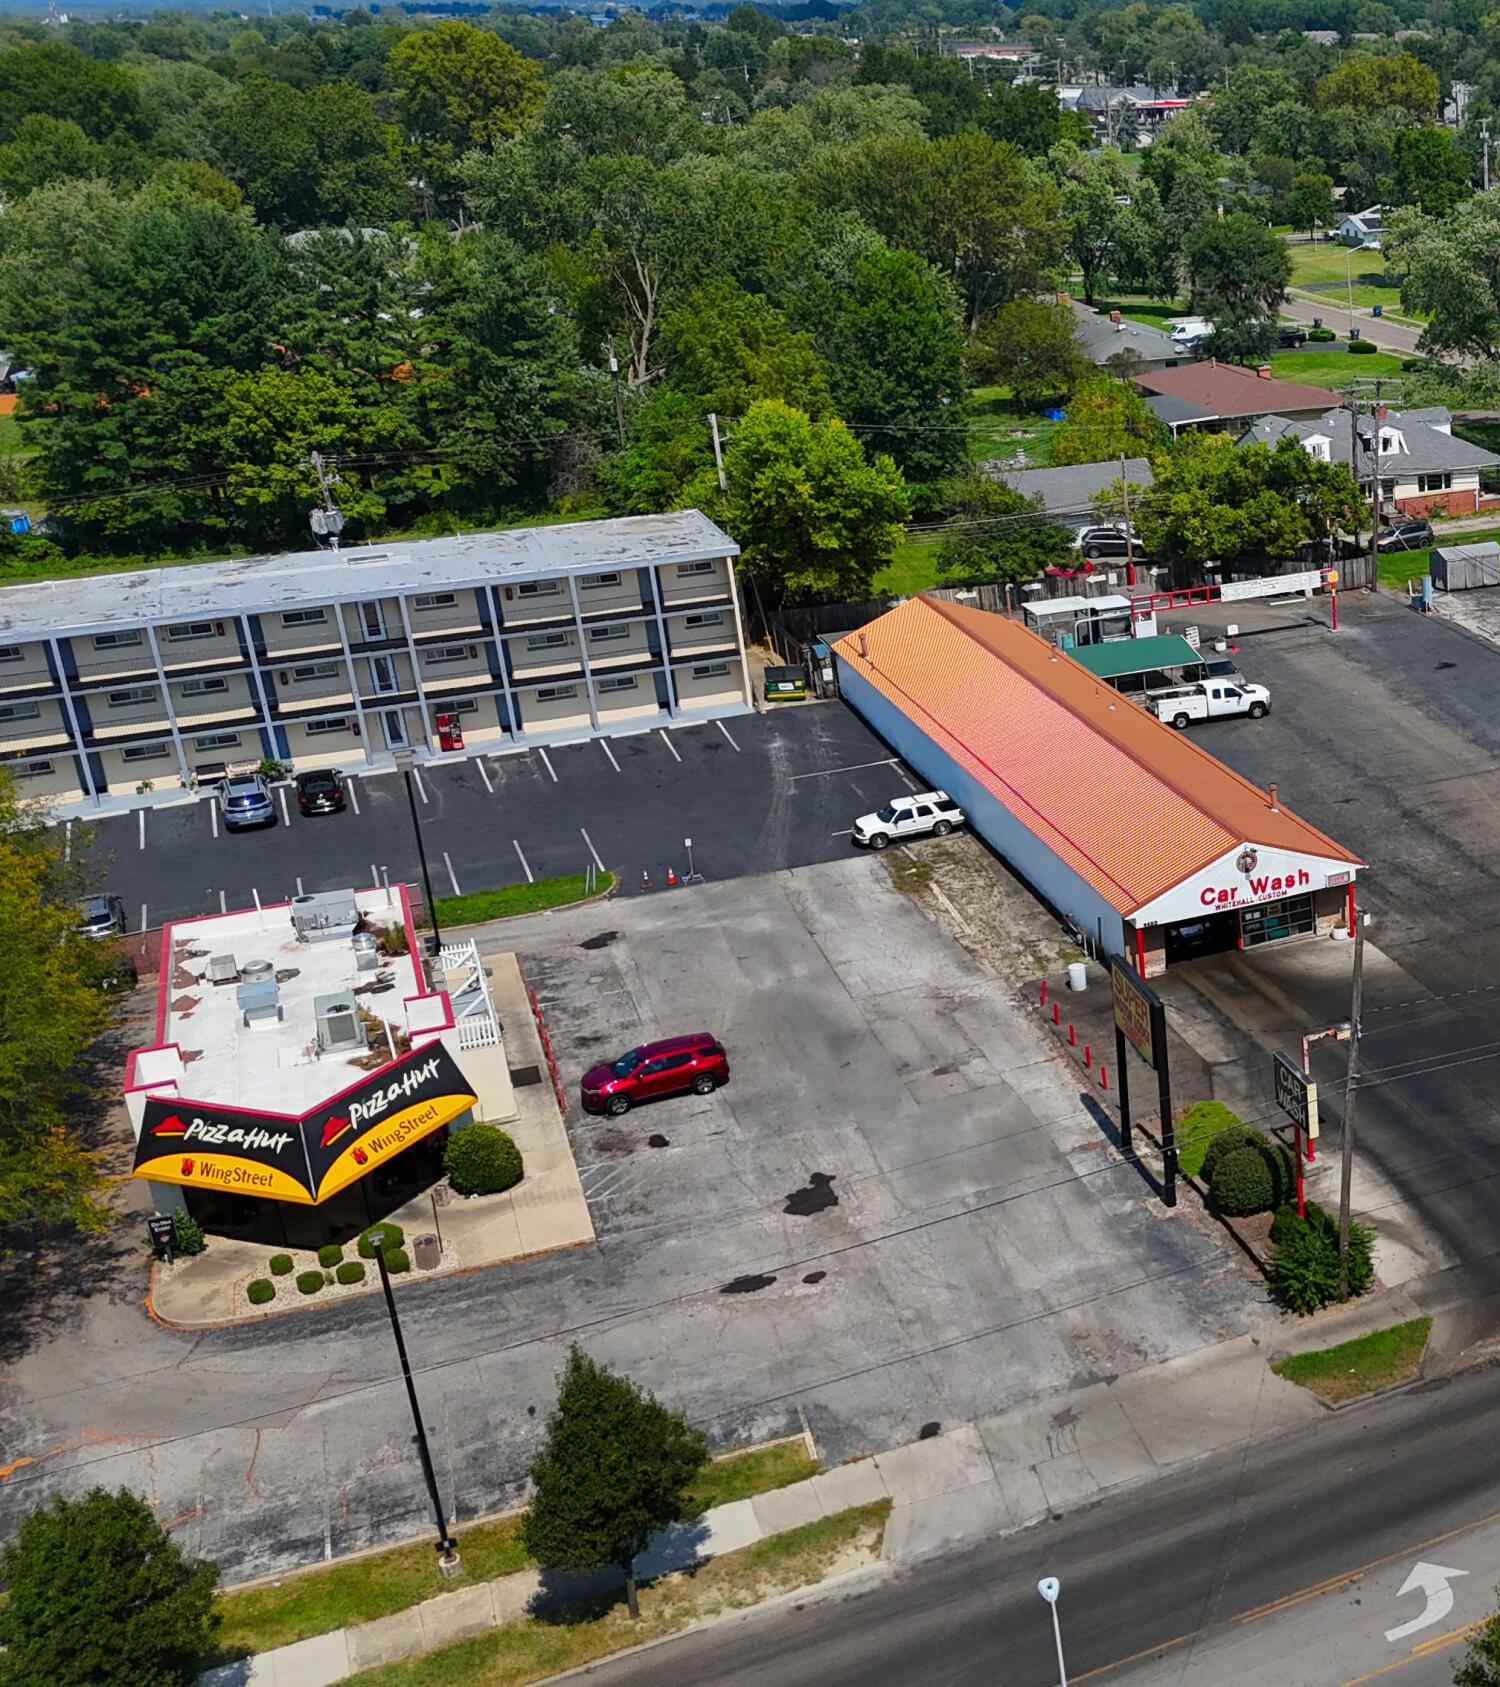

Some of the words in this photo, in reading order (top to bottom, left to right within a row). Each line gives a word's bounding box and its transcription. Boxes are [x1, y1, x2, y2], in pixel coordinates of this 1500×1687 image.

[1200, 886, 1238, 906] Car
[1250, 868, 1310, 897] Wash
[1214, 897, 1255, 911] WHITEHALL
[1258, 889, 1288, 901] CUSTOM
[1114, 969, 1150, 1029] SUPER
[1280, 1066, 1302, 1102] CAR
[1277, 1085, 1306, 1129] WASH
[367, 1104, 440, 1154] WingStreet
[200, 1161, 274, 1188] WingStreet
